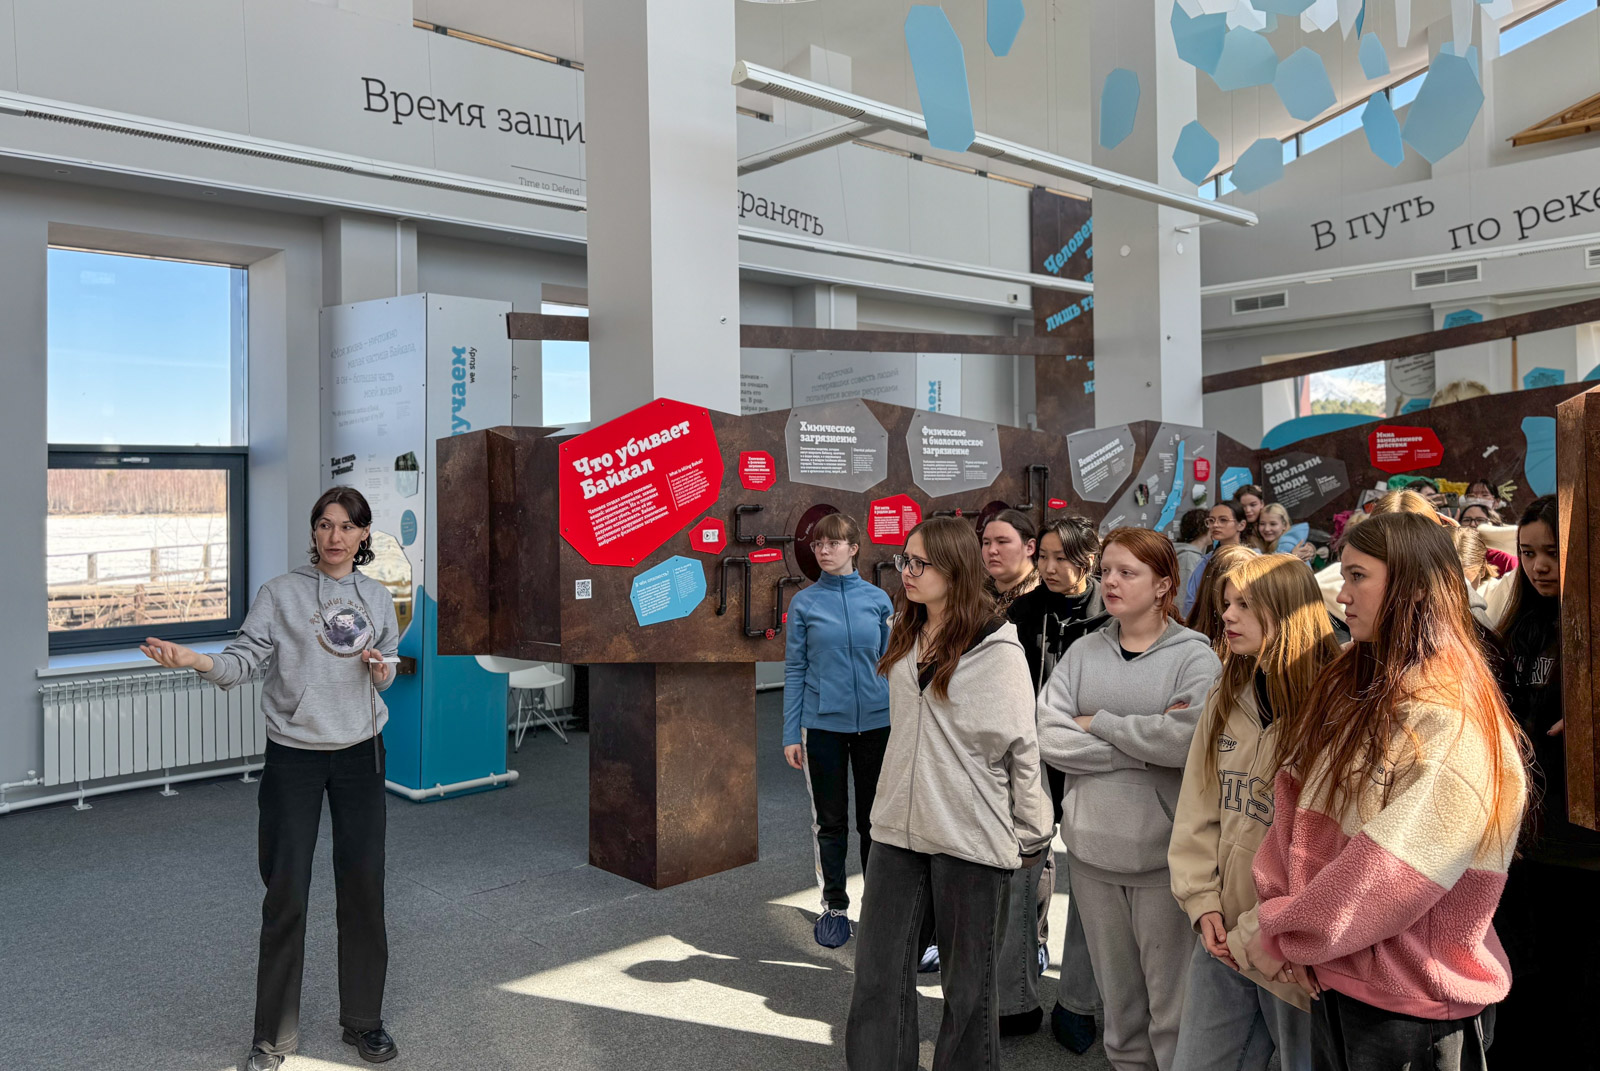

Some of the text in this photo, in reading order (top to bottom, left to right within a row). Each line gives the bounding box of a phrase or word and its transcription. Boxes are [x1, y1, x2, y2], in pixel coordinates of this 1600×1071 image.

[361, 76, 586, 145] Время защи
[518, 176, 580, 196] Time to Defend
[737, 189, 824, 237] ранять
[1310, 195, 1435, 251] В путь
[1448, 217, 1502, 250] по
[1045, 303, 1081, 332] лишь
[468, 346, 477, 383] we study
[799, 421, 856, 434] Химическое
[800, 434, 857, 445] загрязнение
[921, 425, 967, 437] Физическое
[929, 436, 984, 447] биологическое
[572, 421, 690, 476] Что убивает
[922, 447, 970, 458] загрязнение
[1078, 438, 1120, 468] Вещественные
[580, 458, 655, 499] Байкал
[1263, 458, 1288, 474] Это
[1269, 455, 1323, 485] сделали
[1273, 474, 1309, 495] люди
[1218, 769, 1275, 827] TS
